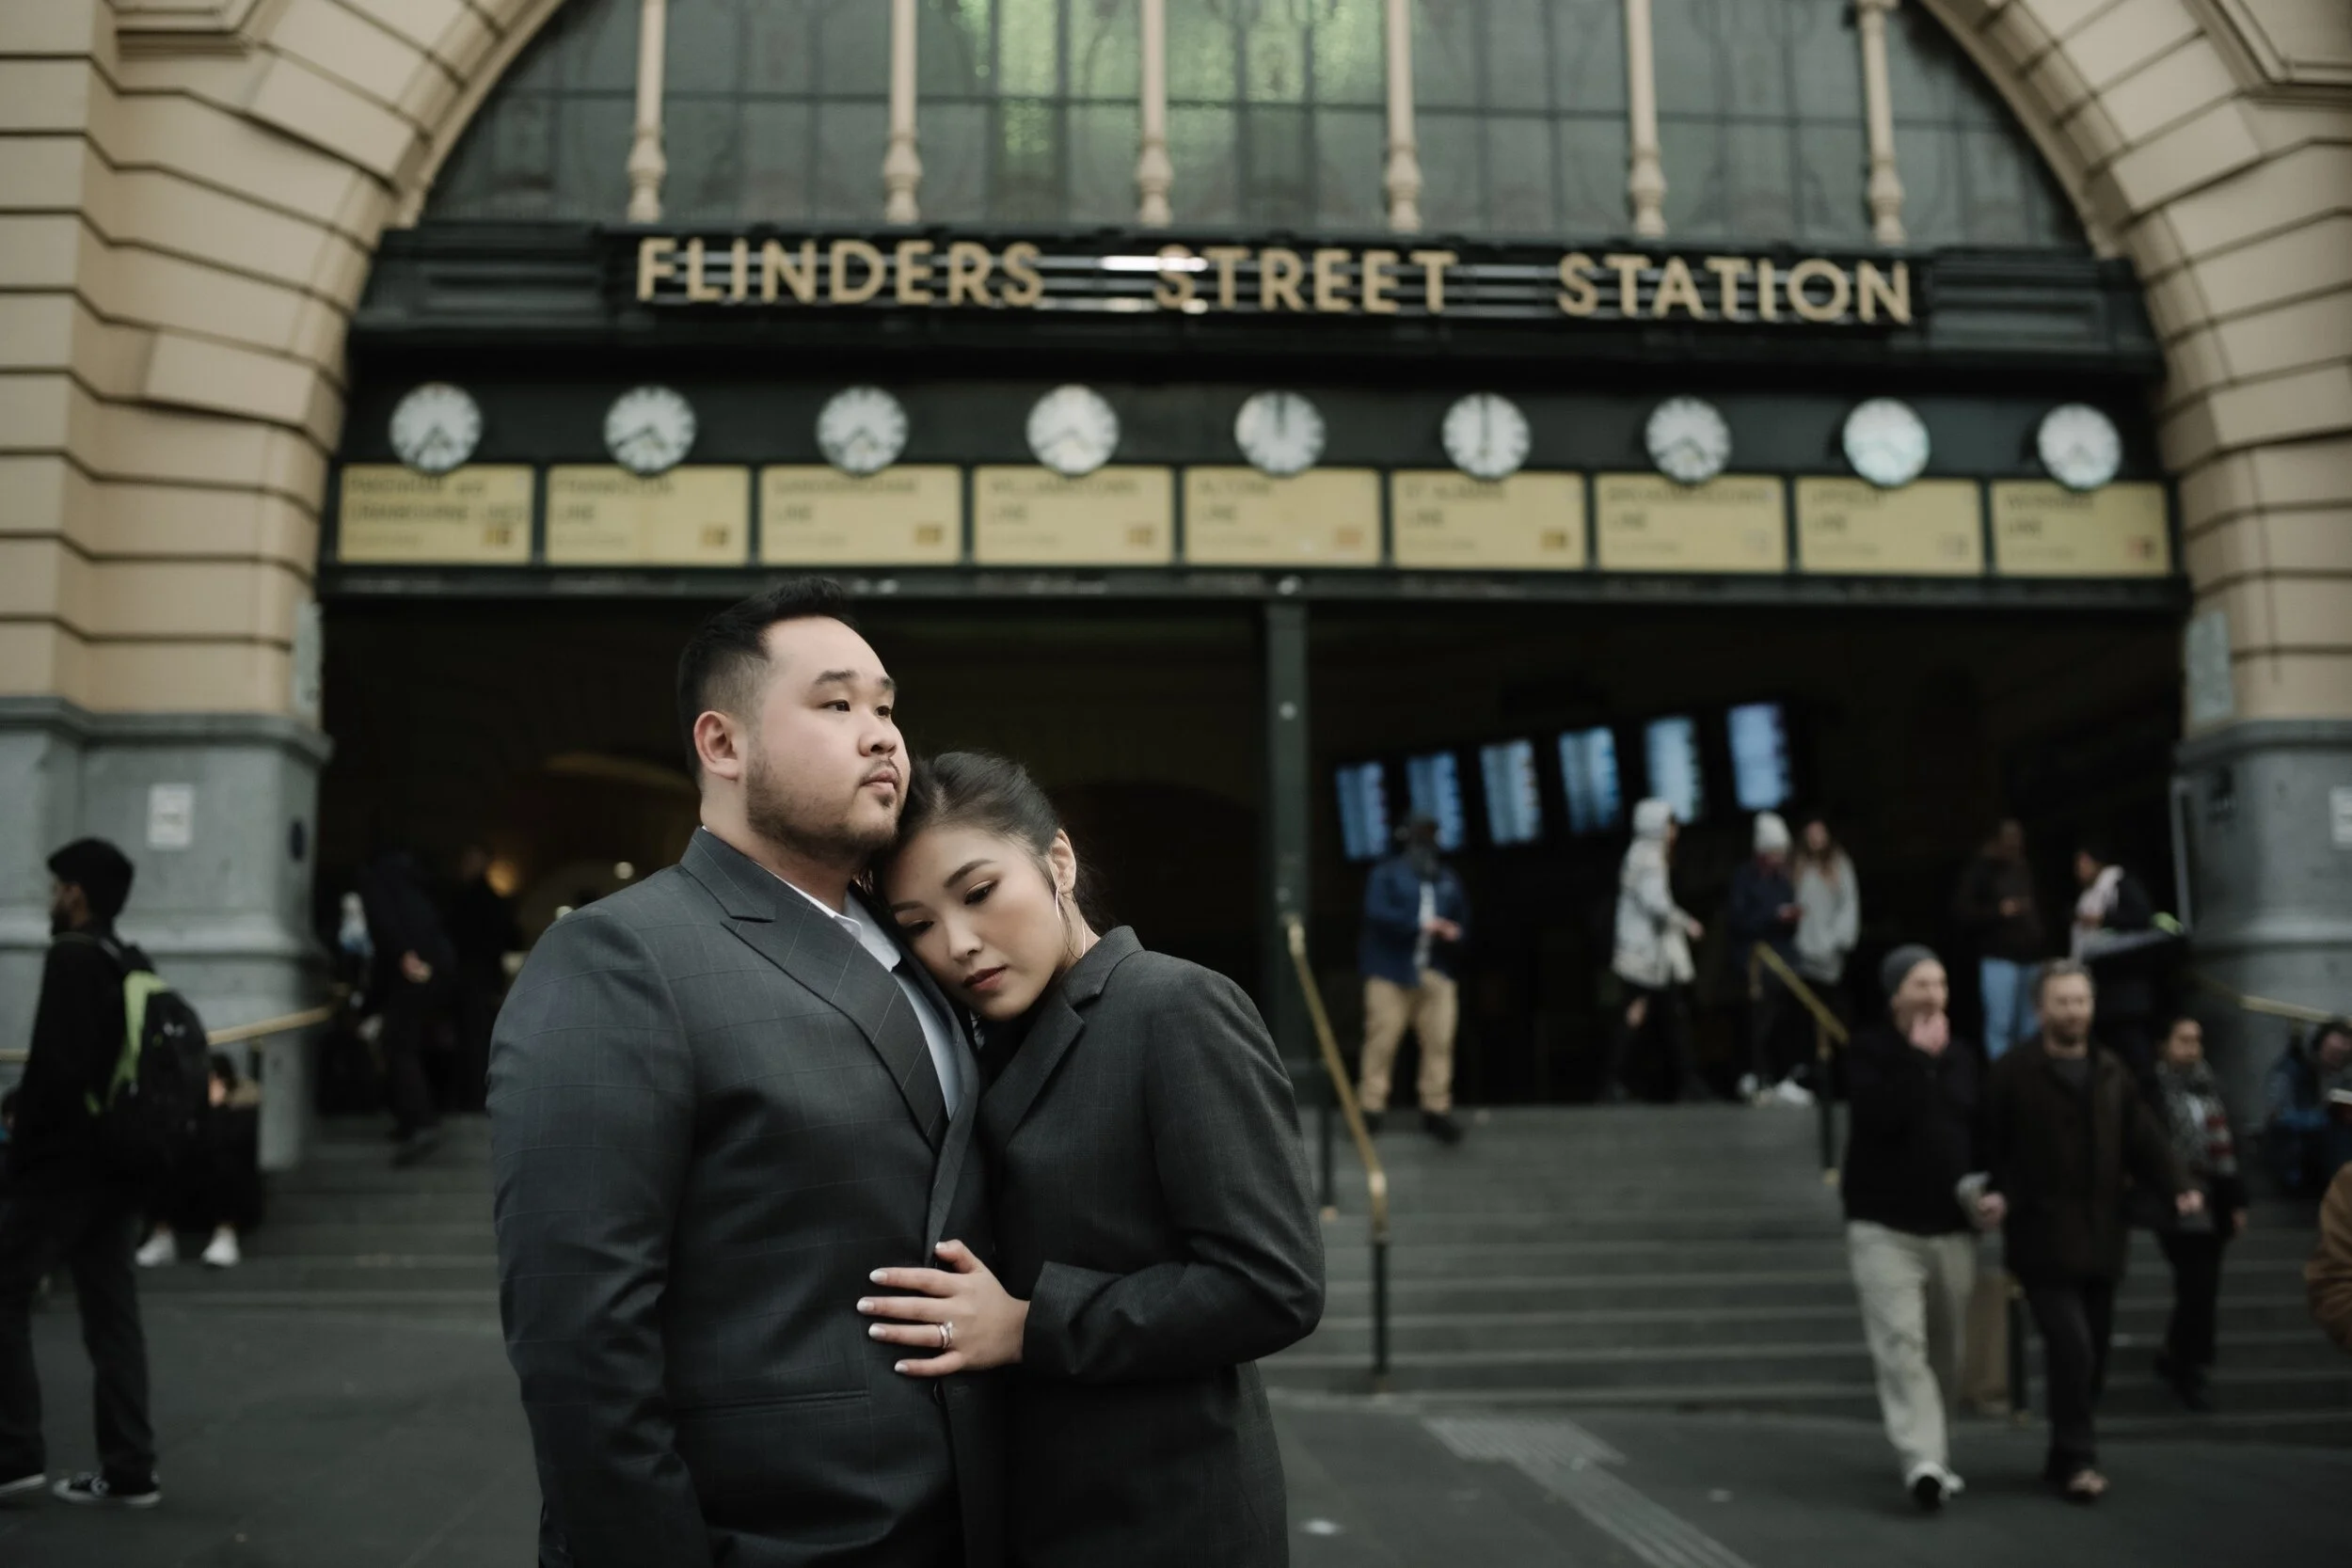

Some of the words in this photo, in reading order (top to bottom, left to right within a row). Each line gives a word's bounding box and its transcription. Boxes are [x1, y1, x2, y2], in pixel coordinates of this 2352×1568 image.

[637, 238, 1042, 306] FLINDERS
[1153, 245, 1457, 313] STREET
[1557, 252, 1911, 324] STATION
